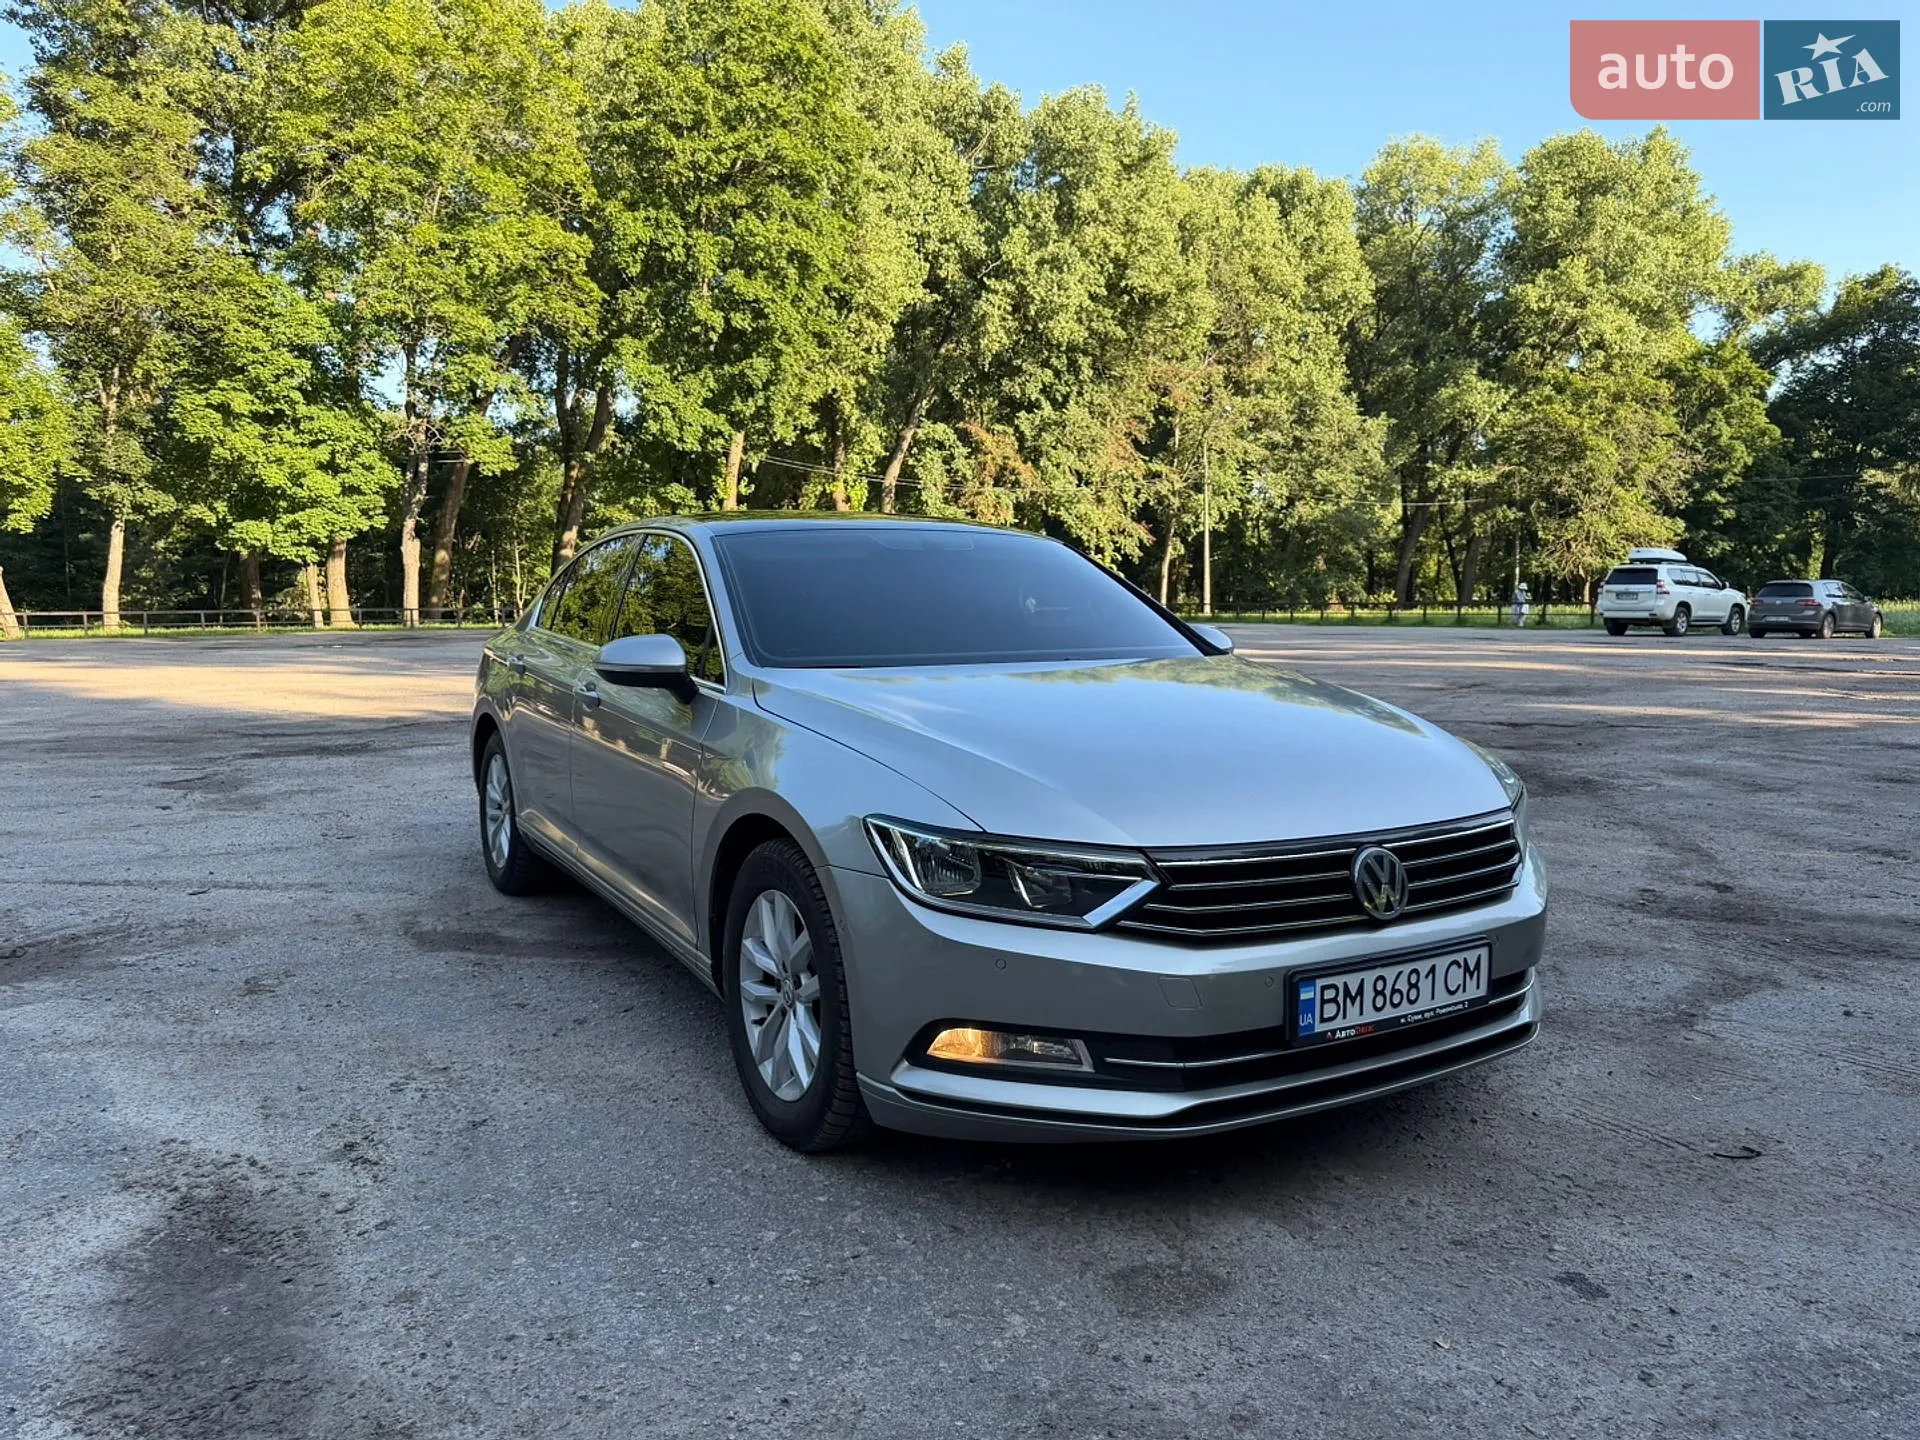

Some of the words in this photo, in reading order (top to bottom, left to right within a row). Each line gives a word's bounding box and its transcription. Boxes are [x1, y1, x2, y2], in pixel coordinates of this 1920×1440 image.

[1319, 977, 1365, 1024] BM
[1372, 963, 1437, 1013] 8681
[1444, 953, 1482, 996] CM
[1300, 1013, 1314, 1026] UA
